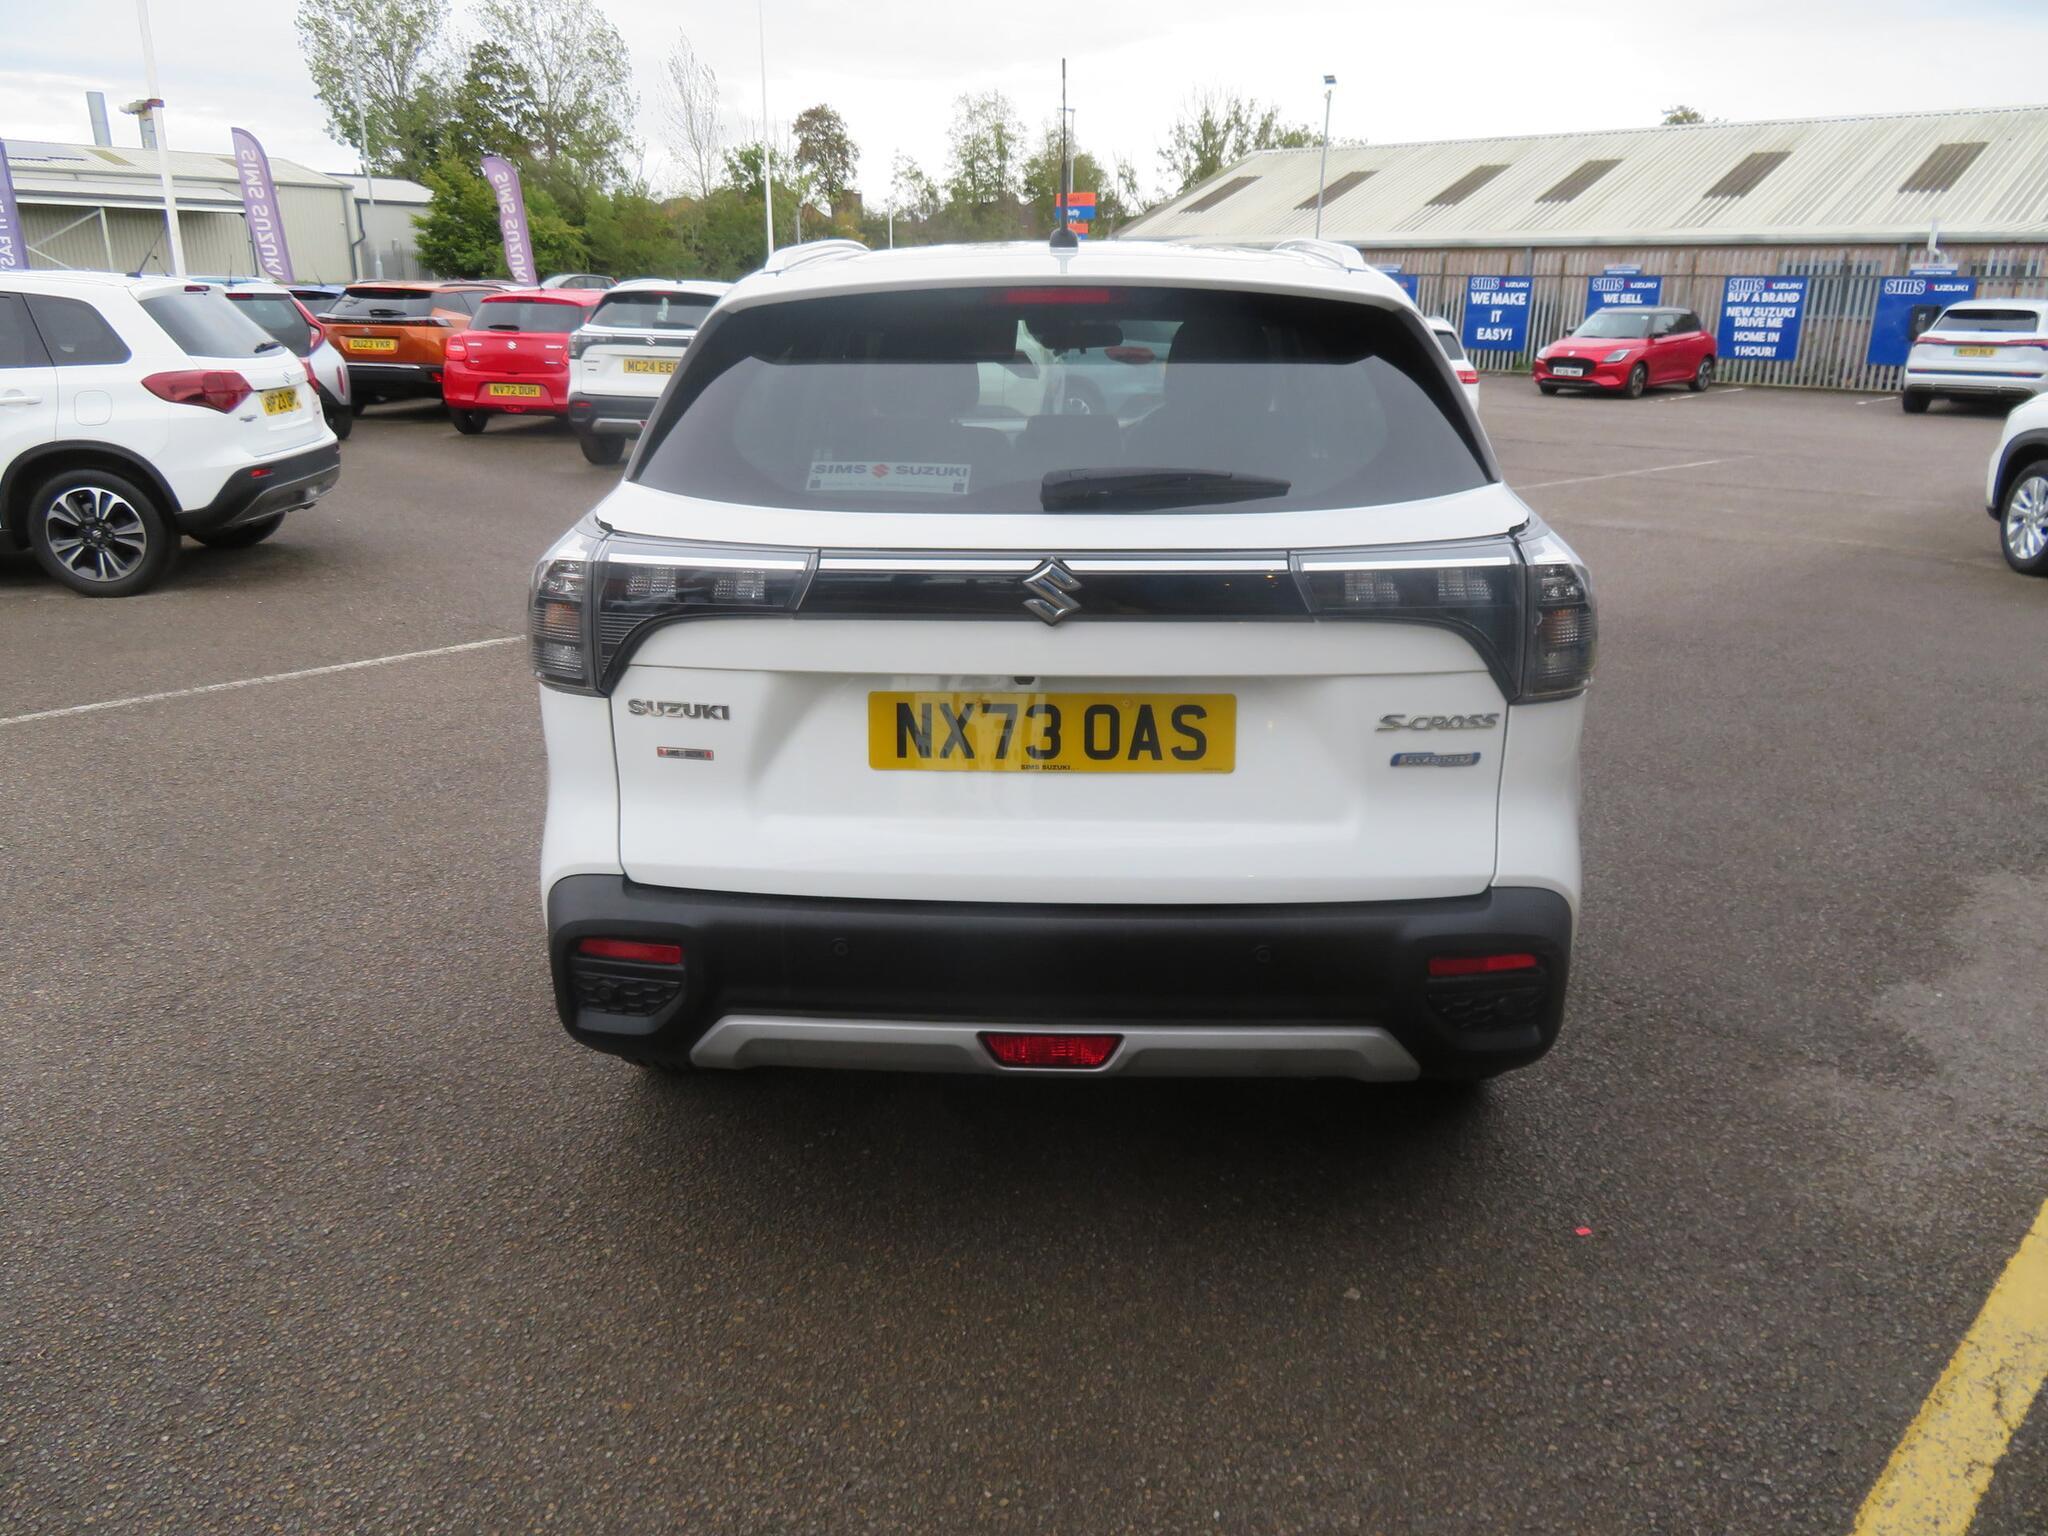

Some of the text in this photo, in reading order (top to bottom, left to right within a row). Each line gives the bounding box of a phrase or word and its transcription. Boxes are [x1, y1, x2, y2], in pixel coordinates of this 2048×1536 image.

[1470, 291, 1528, 306] WE MAKE
[1603, 292, 1643, 304] WE SELL
[1727, 291, 1801, 303] BUY A BRAND
[1490, 310, 1503, 323] IT
[1726, 306, 1797, 318] NEW SUZUKI
[1734, 317, 1784, 328] DRIVE ME
[1476, 327, 1513, 341] EASY!
[1733, 331, 1781, 342] HOME IN
[1740, 346, 1777, 357] HOUR!
[814, 464, 968, 477] SIMS SUZUKI
[628, 698, 730, 720] SUZUKI
[896, 702, 1208, 761] NX73 OAS
